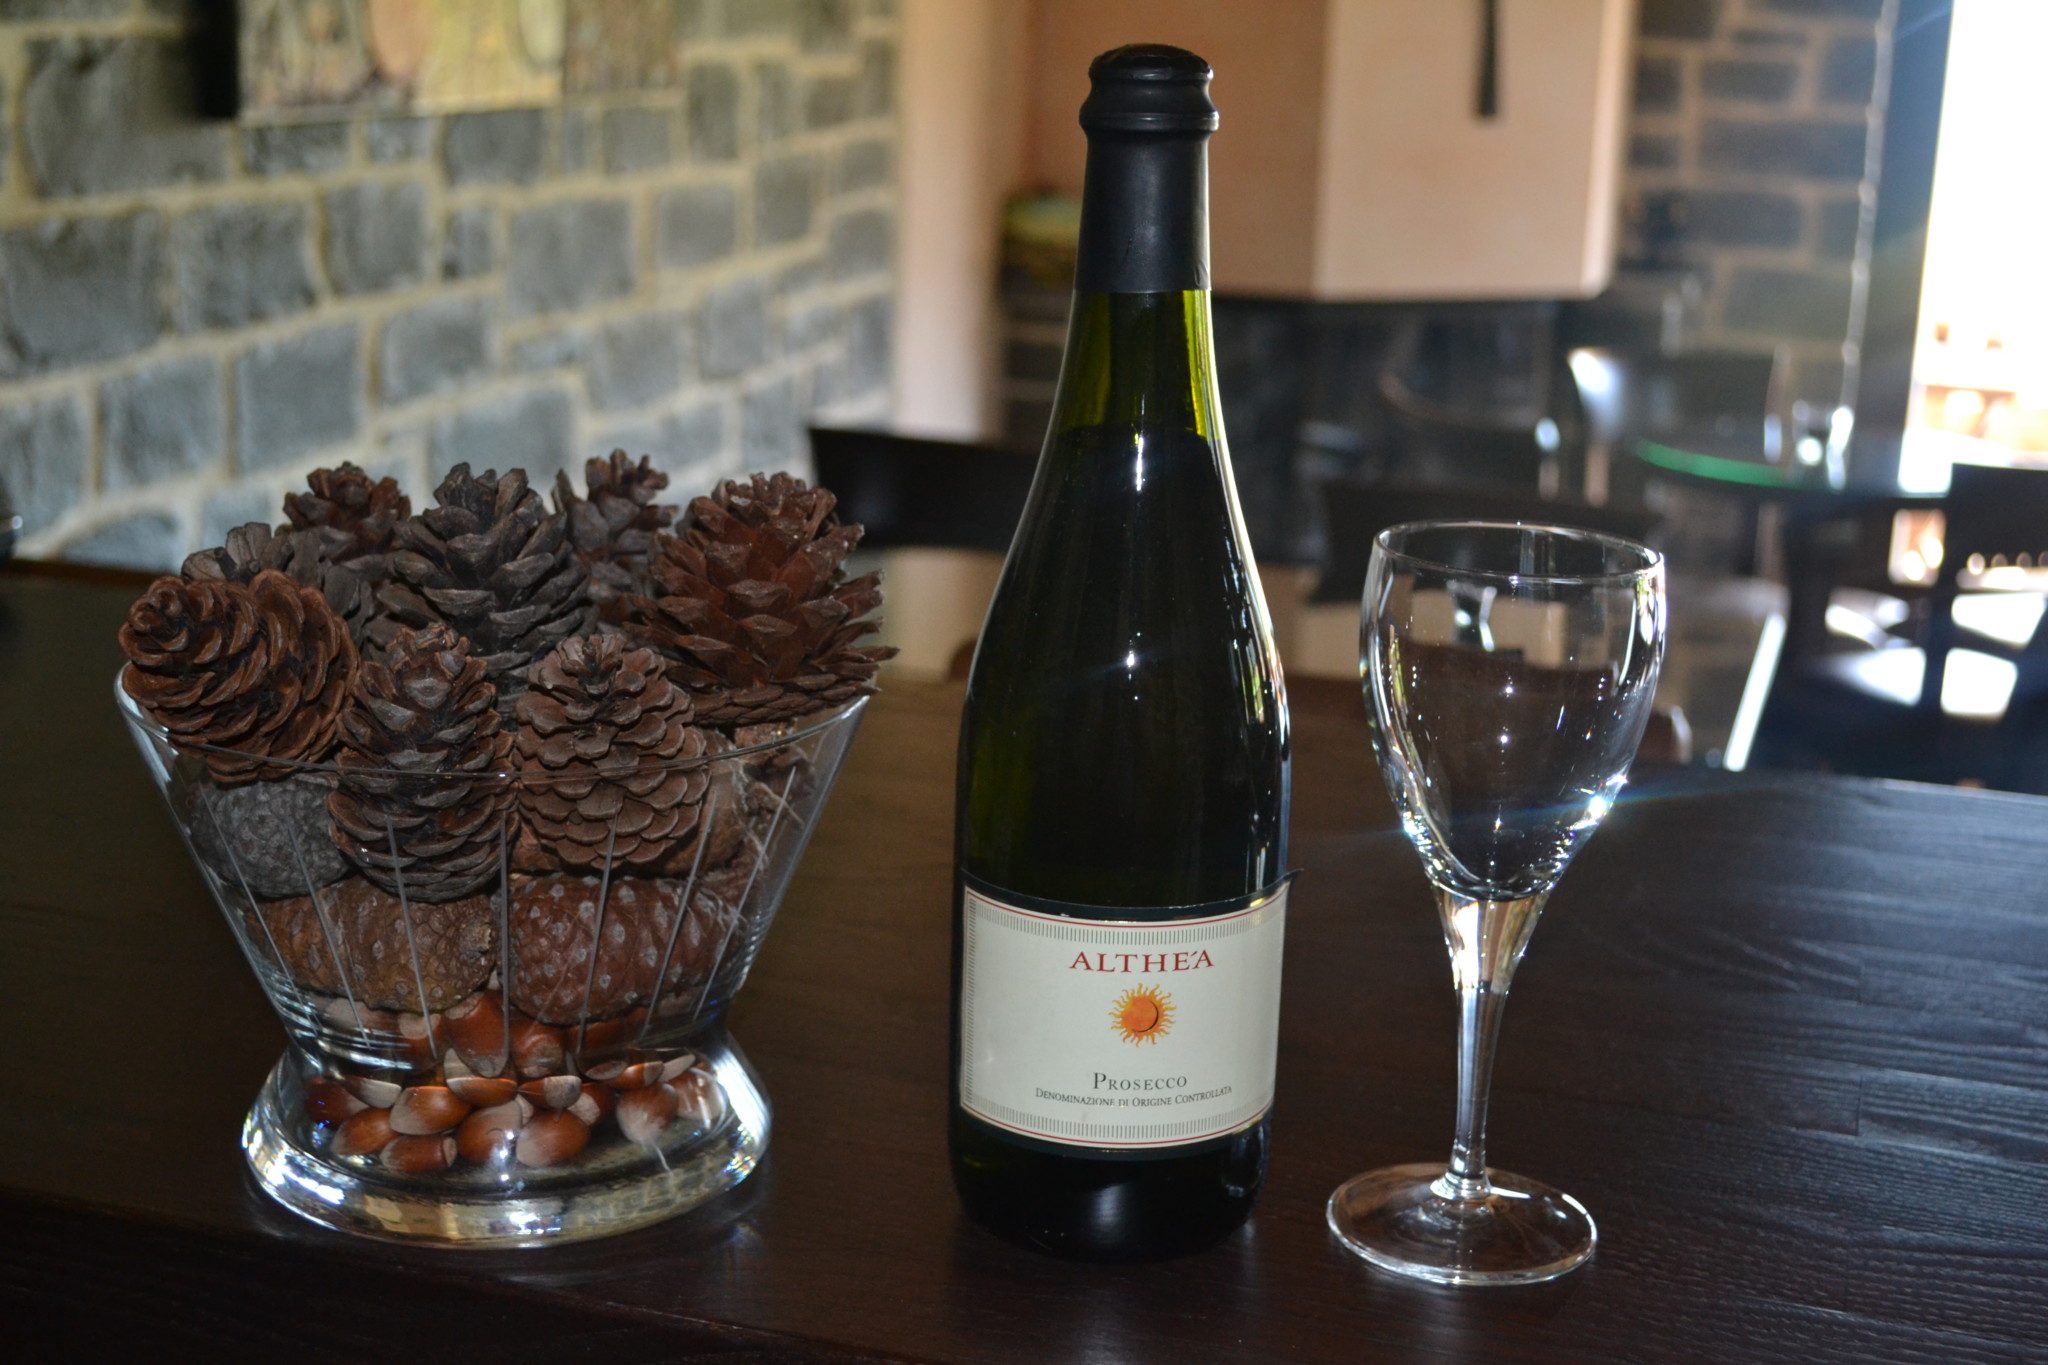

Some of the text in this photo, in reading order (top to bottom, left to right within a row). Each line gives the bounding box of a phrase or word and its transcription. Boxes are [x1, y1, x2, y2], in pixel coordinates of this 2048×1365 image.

[1093, 1071, 1187, 1091] PROSECCO
[1035, 1087, 1116, 1107] DENOMINAZIONE
[1132, 1097, 1172, 1107] ORIGINE
[1175, 1085, 1232, 1104] CONTROLLATA
